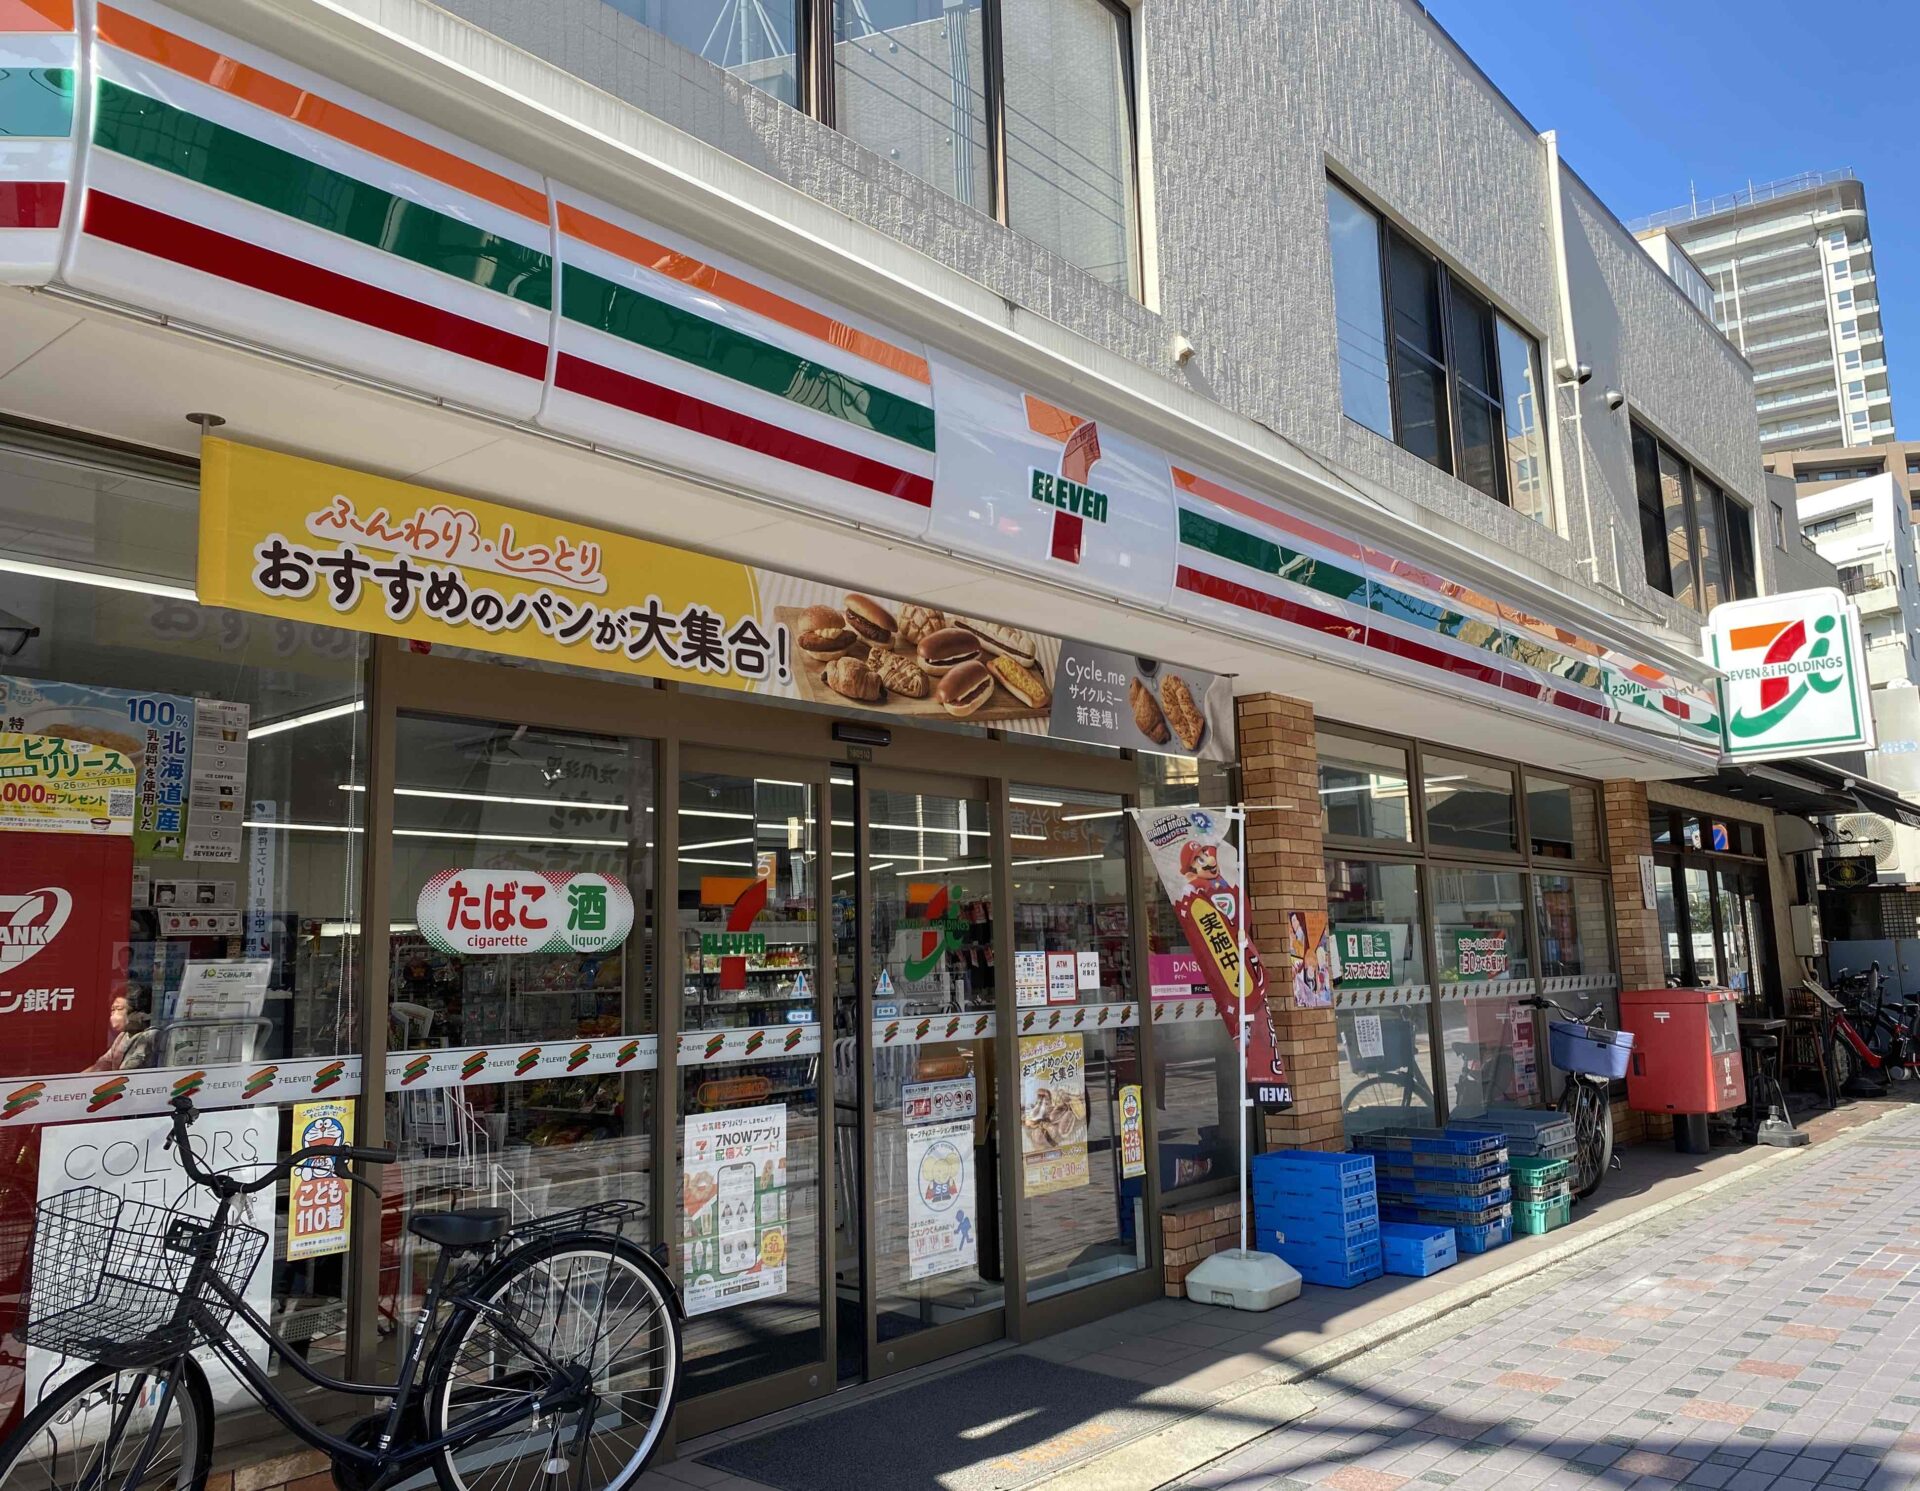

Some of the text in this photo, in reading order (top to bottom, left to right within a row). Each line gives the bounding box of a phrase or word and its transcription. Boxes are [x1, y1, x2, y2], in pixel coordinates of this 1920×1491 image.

[259, 540, 787, 677] おすすめのパンが大集合!
[1065, 657, 1126, 686] Cycle.me
[1778, 656, 1843, 675] HOLDINGS
[1069, 684, 1123, 706] サイクルミー
[127, 699, 188, 728] 100%
[1076, 706, 1119, 730] 新登場!
[43, 753, 125, 778] リリース
[141, 729, 160, 831] 乳原料を使用した
[155, 731, 186, 832] 北海道産
[447, 880, 607, 931] たばこ 酒
[467, 934, 607, 949] cigarette liquor
[1056, 960, 1068, 968] ATM
[1050, 1063, 1078, 1084] 大集合!
[716, 1127, 780, 1147] 7NOWアプリ
[299, 1179, 342, 1207] こども
[297, 1205, 343, 1233] 110番
